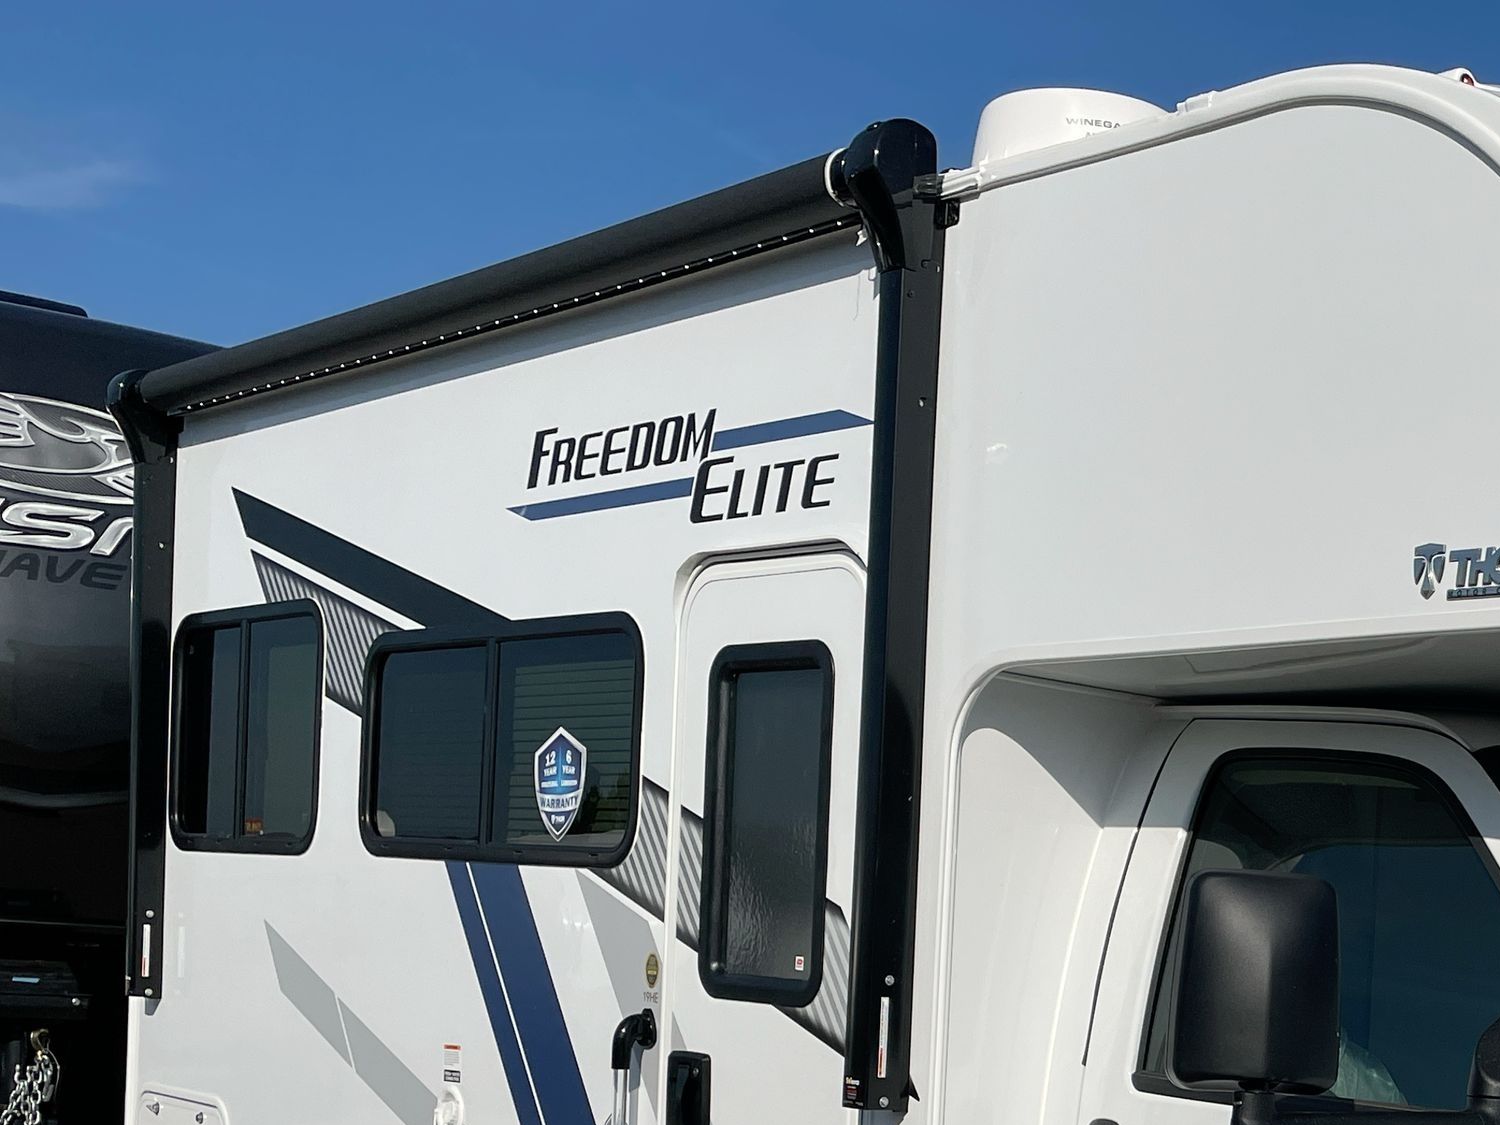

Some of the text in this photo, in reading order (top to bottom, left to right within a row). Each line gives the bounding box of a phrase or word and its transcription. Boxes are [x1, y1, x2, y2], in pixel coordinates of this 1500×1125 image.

[1066, 117, 1121, 129] WINEGA
[526, 408, 717, 489] FREEDOM
[690, 453, 839, 523] ELITE
[0, 549, 128, 590] AVE
[545, 750, 557, 767] 12
[565, 749, 572, 765] 6
[543, 766, 557, 777] YEAR
[562, 764, 576, 775] YEAR
[540, 795, 578, 809] WARRANTY
